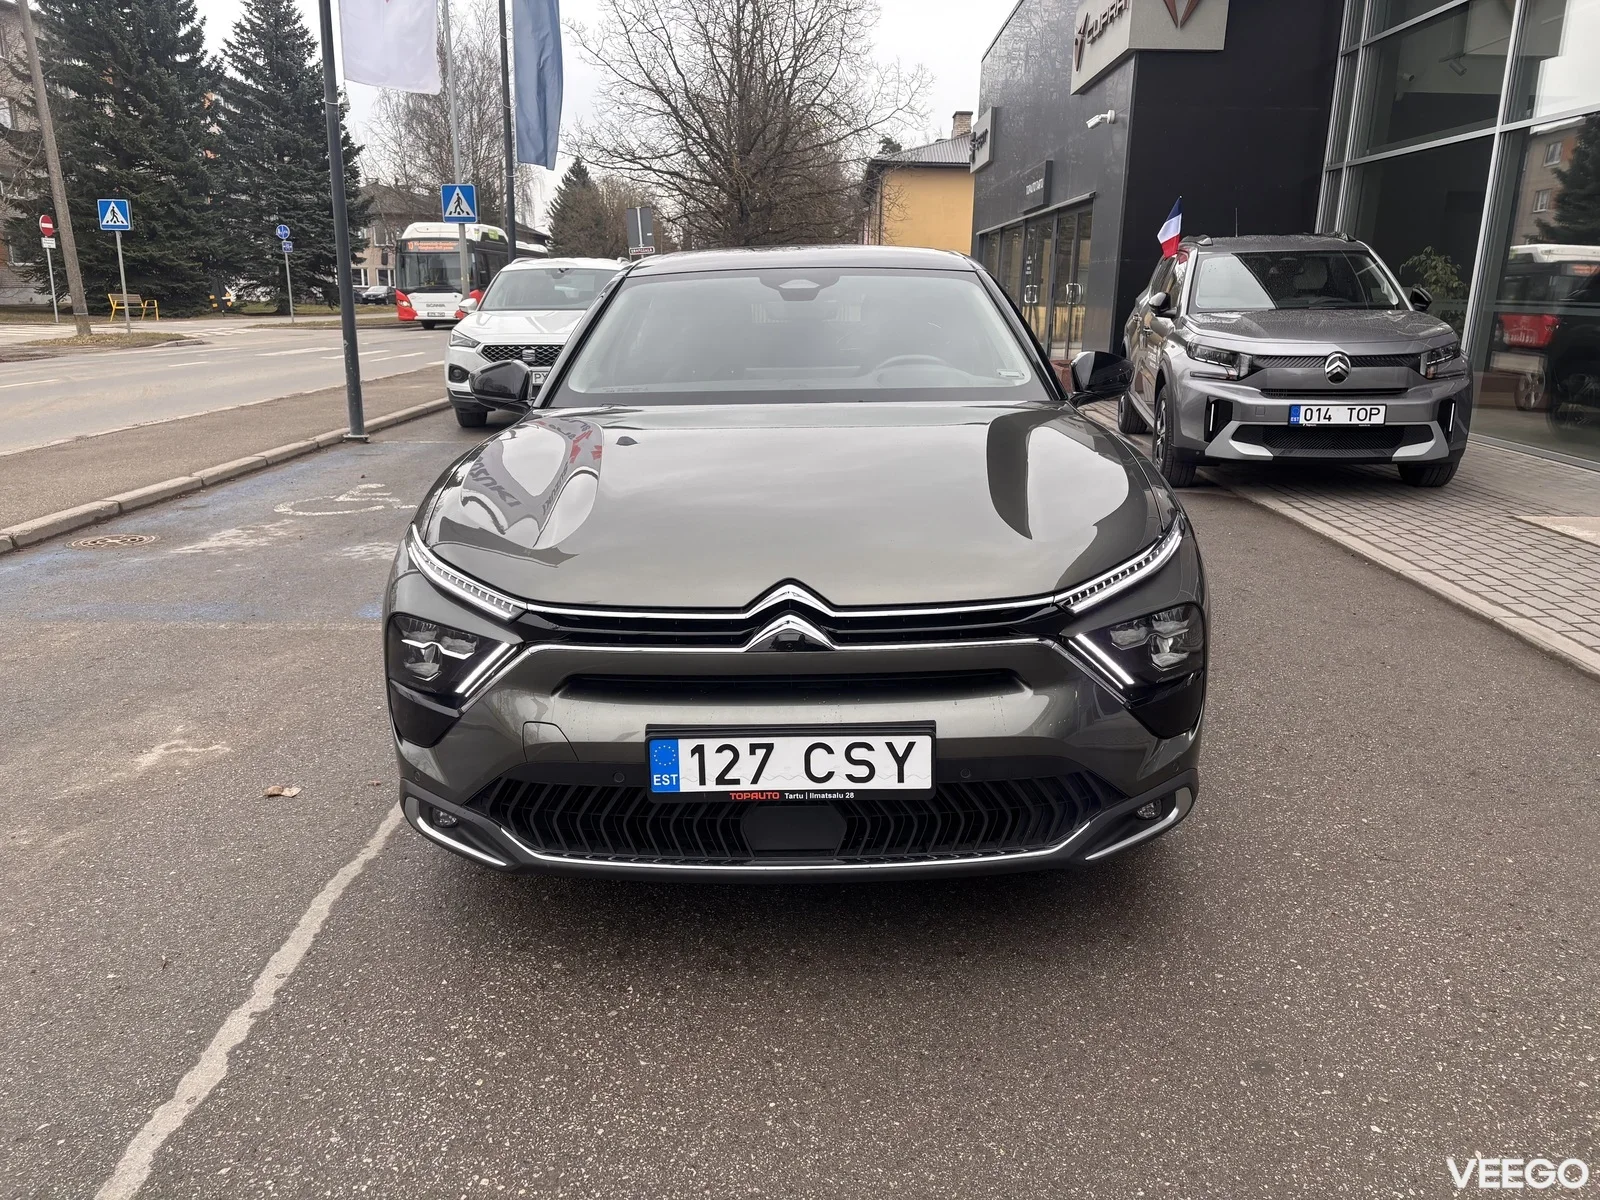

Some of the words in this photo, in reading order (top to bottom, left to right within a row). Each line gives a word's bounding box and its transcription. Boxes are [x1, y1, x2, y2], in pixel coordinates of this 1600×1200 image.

[1086, 0, 1129, 44] CUPRA
[1303, 407, 1332, 422] 014
[1347, 407, 1381, 422] TOP
[690, 742, 775, 786] 127
[804, 741, 917, 784] CSY
[653, 774, 678, 786] EST
[729, 792, 780, 800] TOPAUTO
[784, 792, 804, 800] Tartu
[809, 792, 844, 800] Ilmatsalu
[845, 791, 855, 799] 28
